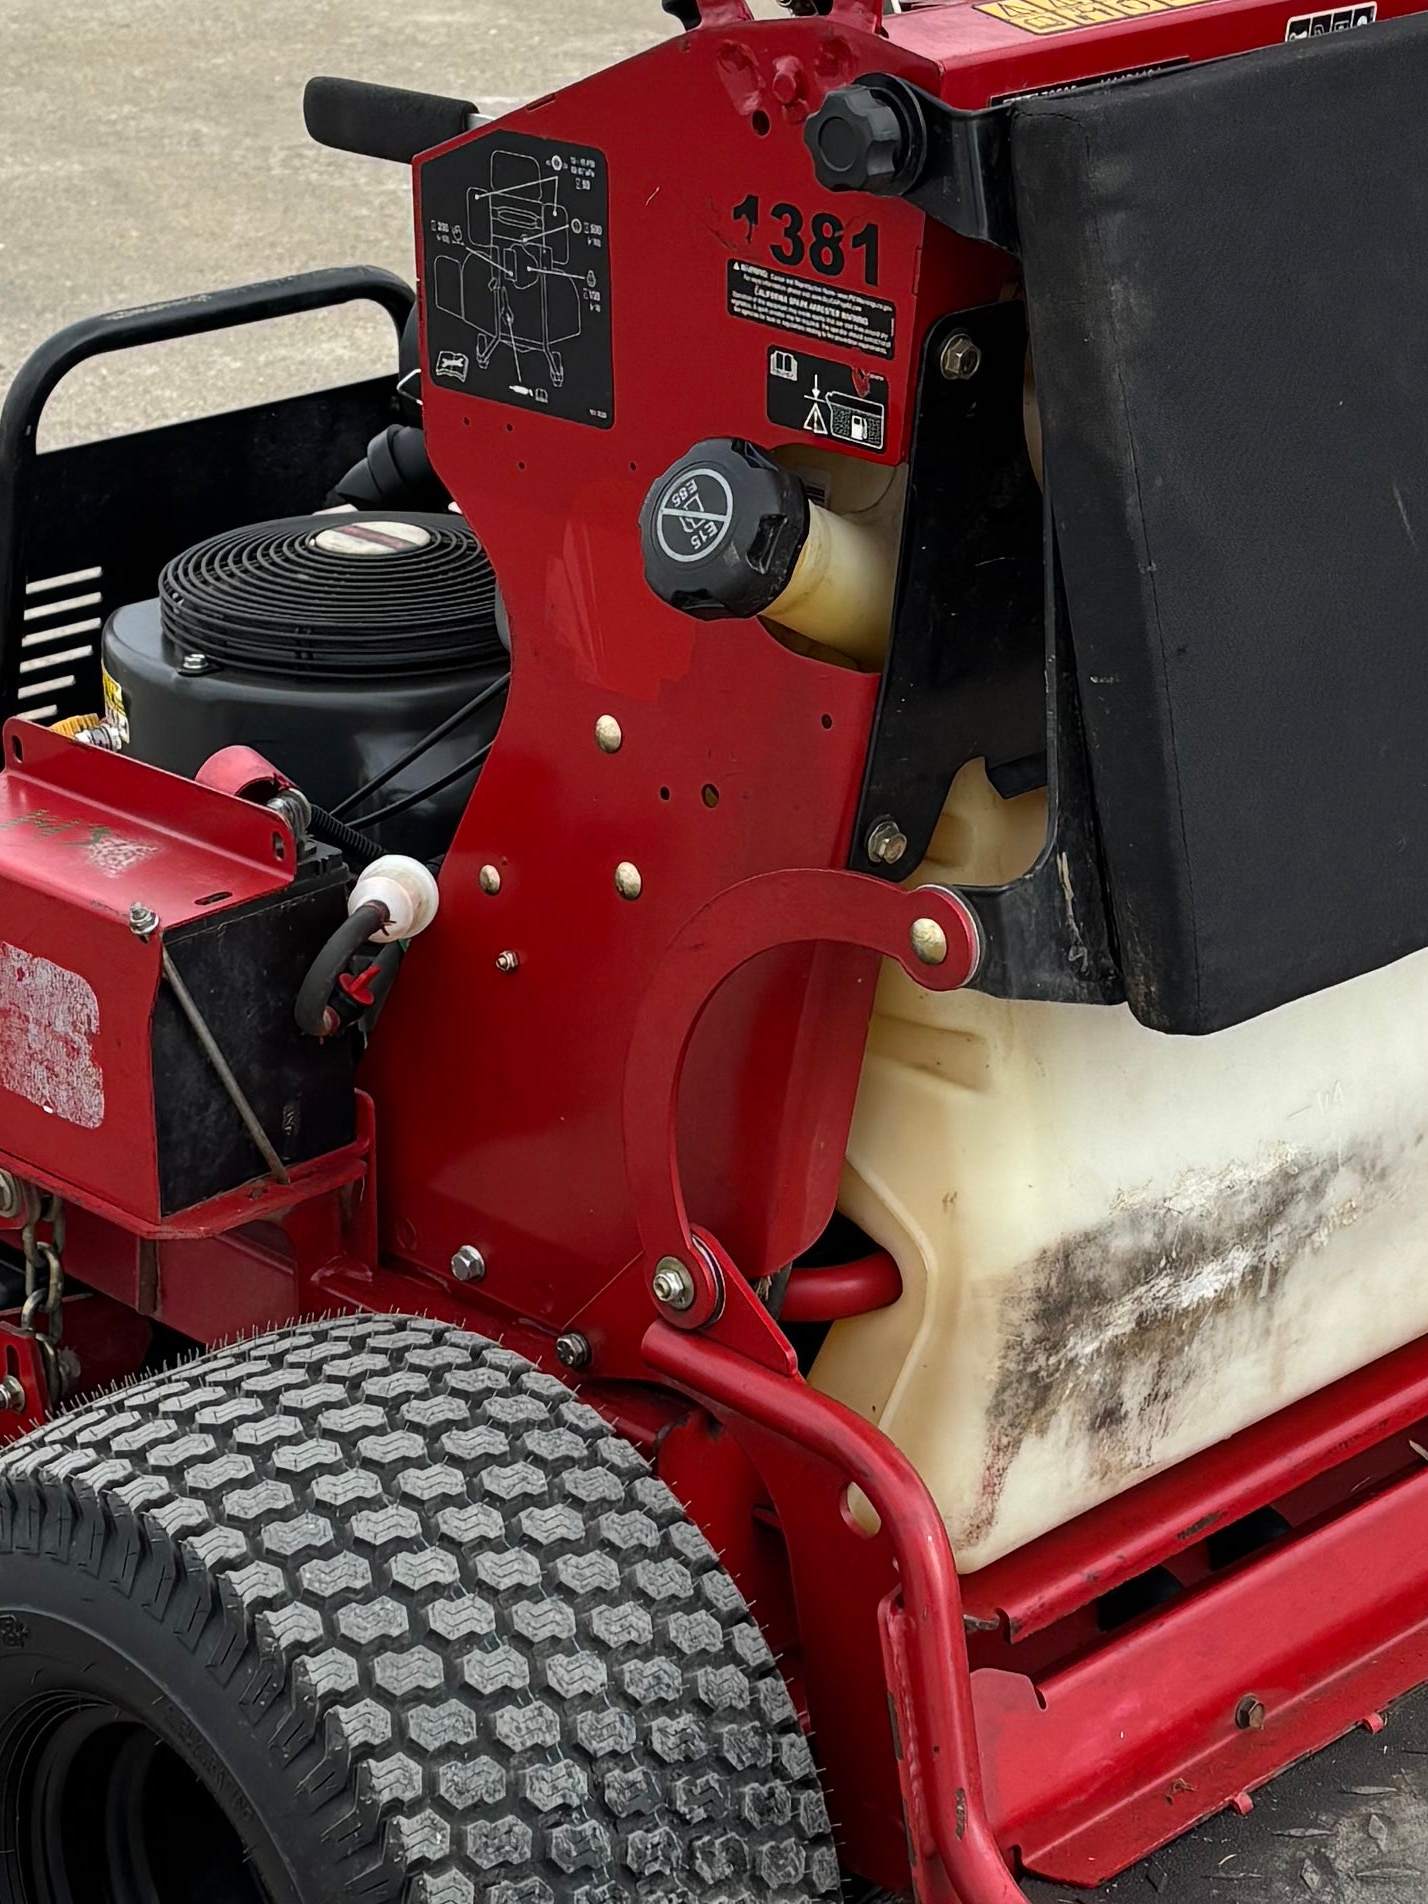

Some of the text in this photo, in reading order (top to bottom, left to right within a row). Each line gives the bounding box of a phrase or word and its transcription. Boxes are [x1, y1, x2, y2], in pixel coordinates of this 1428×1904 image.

[733, 194, 879, 287] 1381
[672, 479, 698, 508] E85
[690, 521, 718, 550] E15
